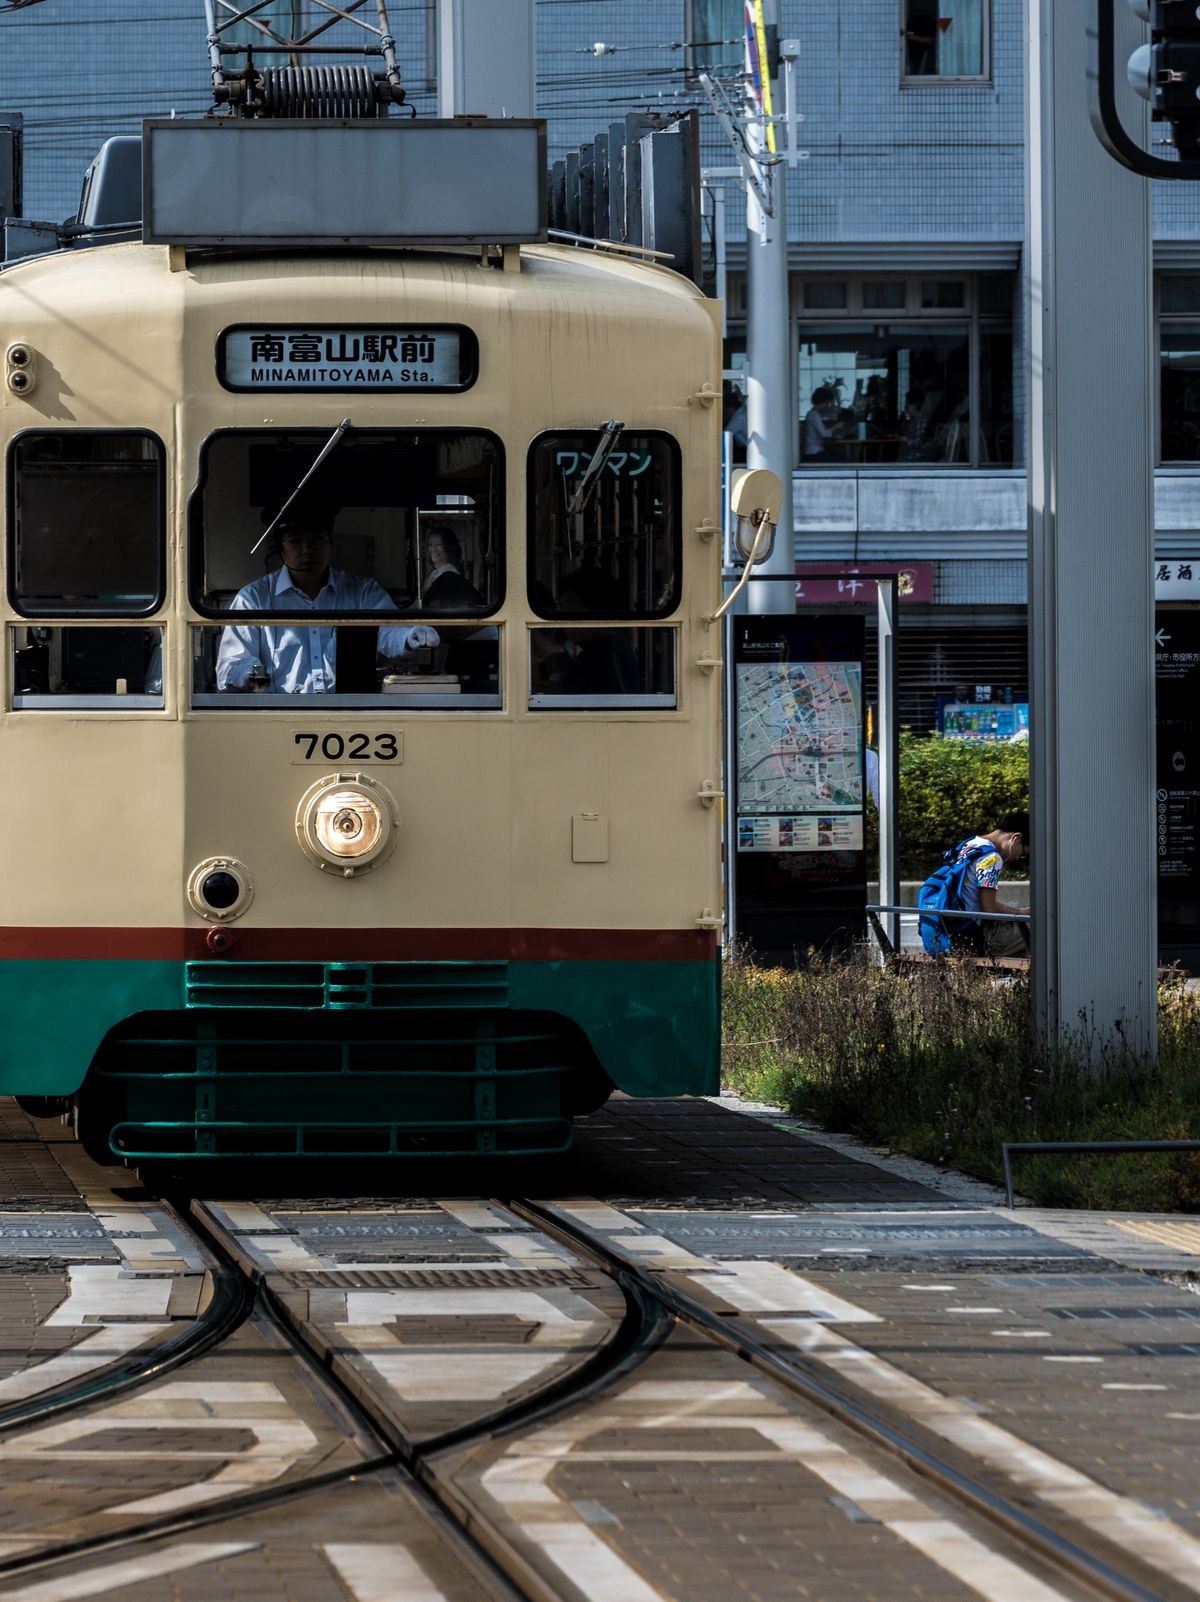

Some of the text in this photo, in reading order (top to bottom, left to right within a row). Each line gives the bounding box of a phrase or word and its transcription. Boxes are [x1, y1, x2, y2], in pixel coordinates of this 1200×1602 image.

[250, 334, 436, 363] 南富山駅前
[251, 369, 435, 382] MINAMITOYAMA Sta.
[295, 733, 398, 760] 7023
